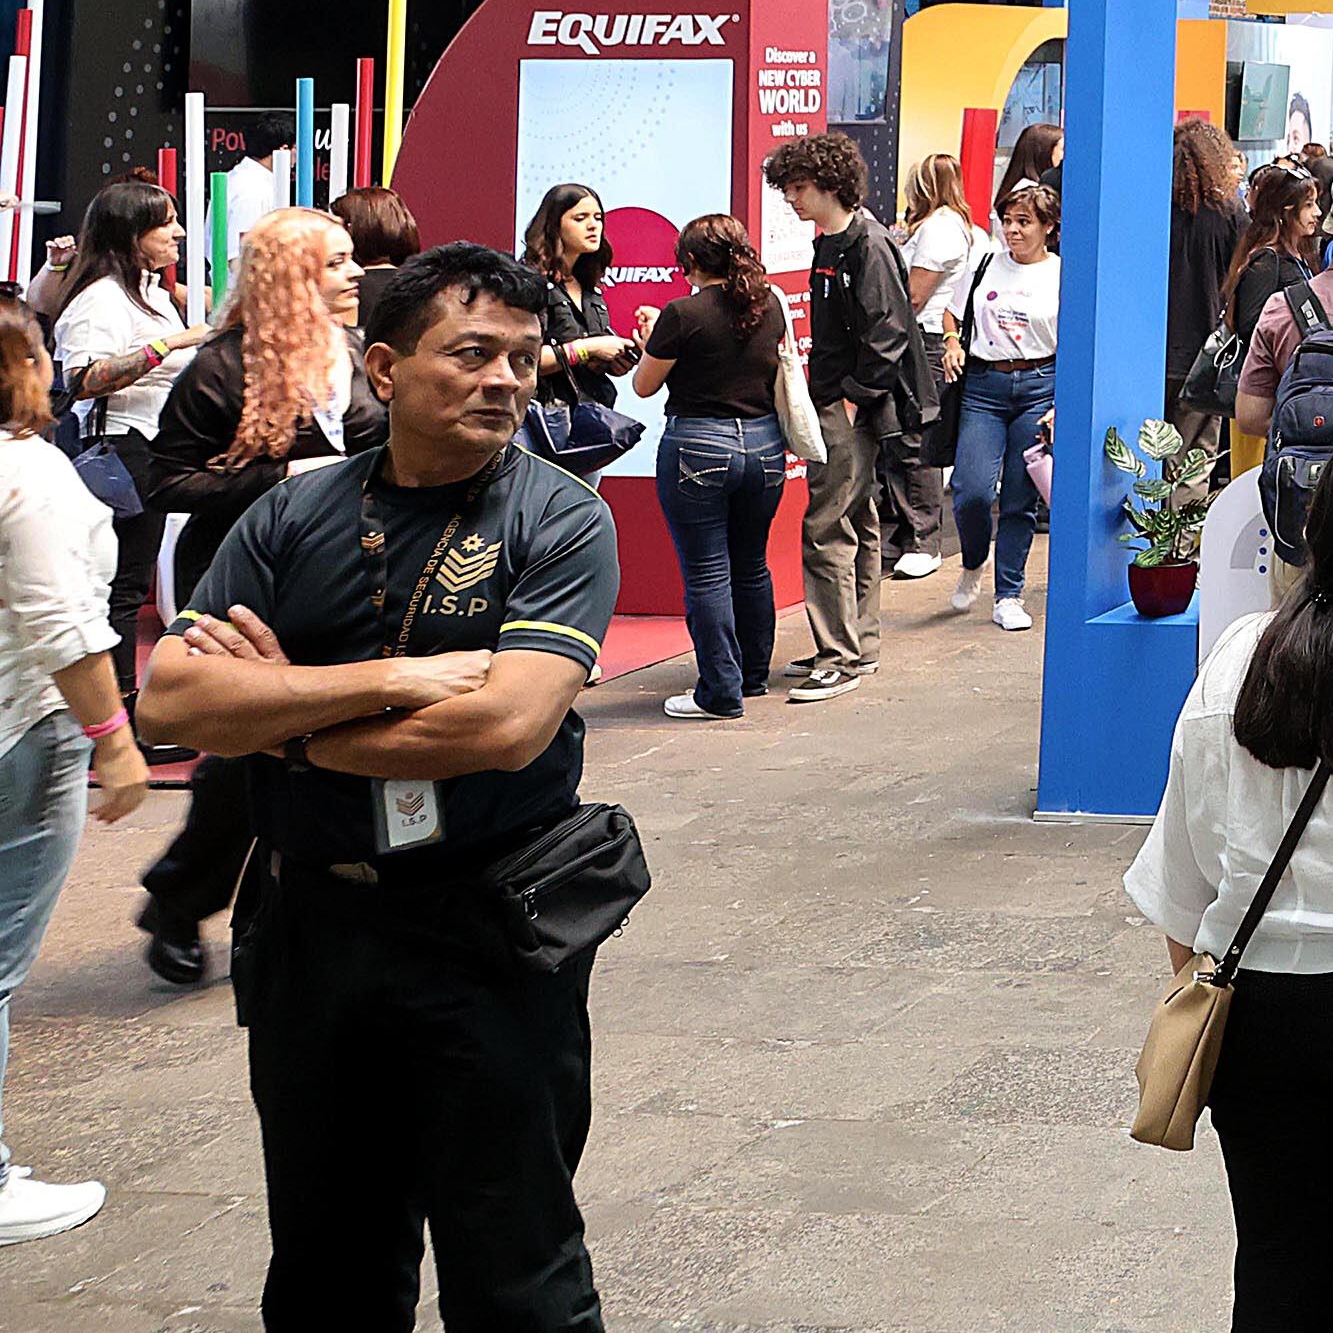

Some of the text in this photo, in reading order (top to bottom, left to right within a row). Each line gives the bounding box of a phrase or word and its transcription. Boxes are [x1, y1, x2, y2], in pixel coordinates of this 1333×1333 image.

[527, 11, 731, 55] EQUIFAX
[765, 47, 816, 64] Discover a
[758, 69, 821, 87] NEW CYBER
[759, 89, 821, 114] WORLD
[771, 119, 808, 137] with us
[430, 513, 463, 559] AGENCIA
[422, 558, 439, 575] DE
[399, 575, 430, 643] SEGURIDAD
